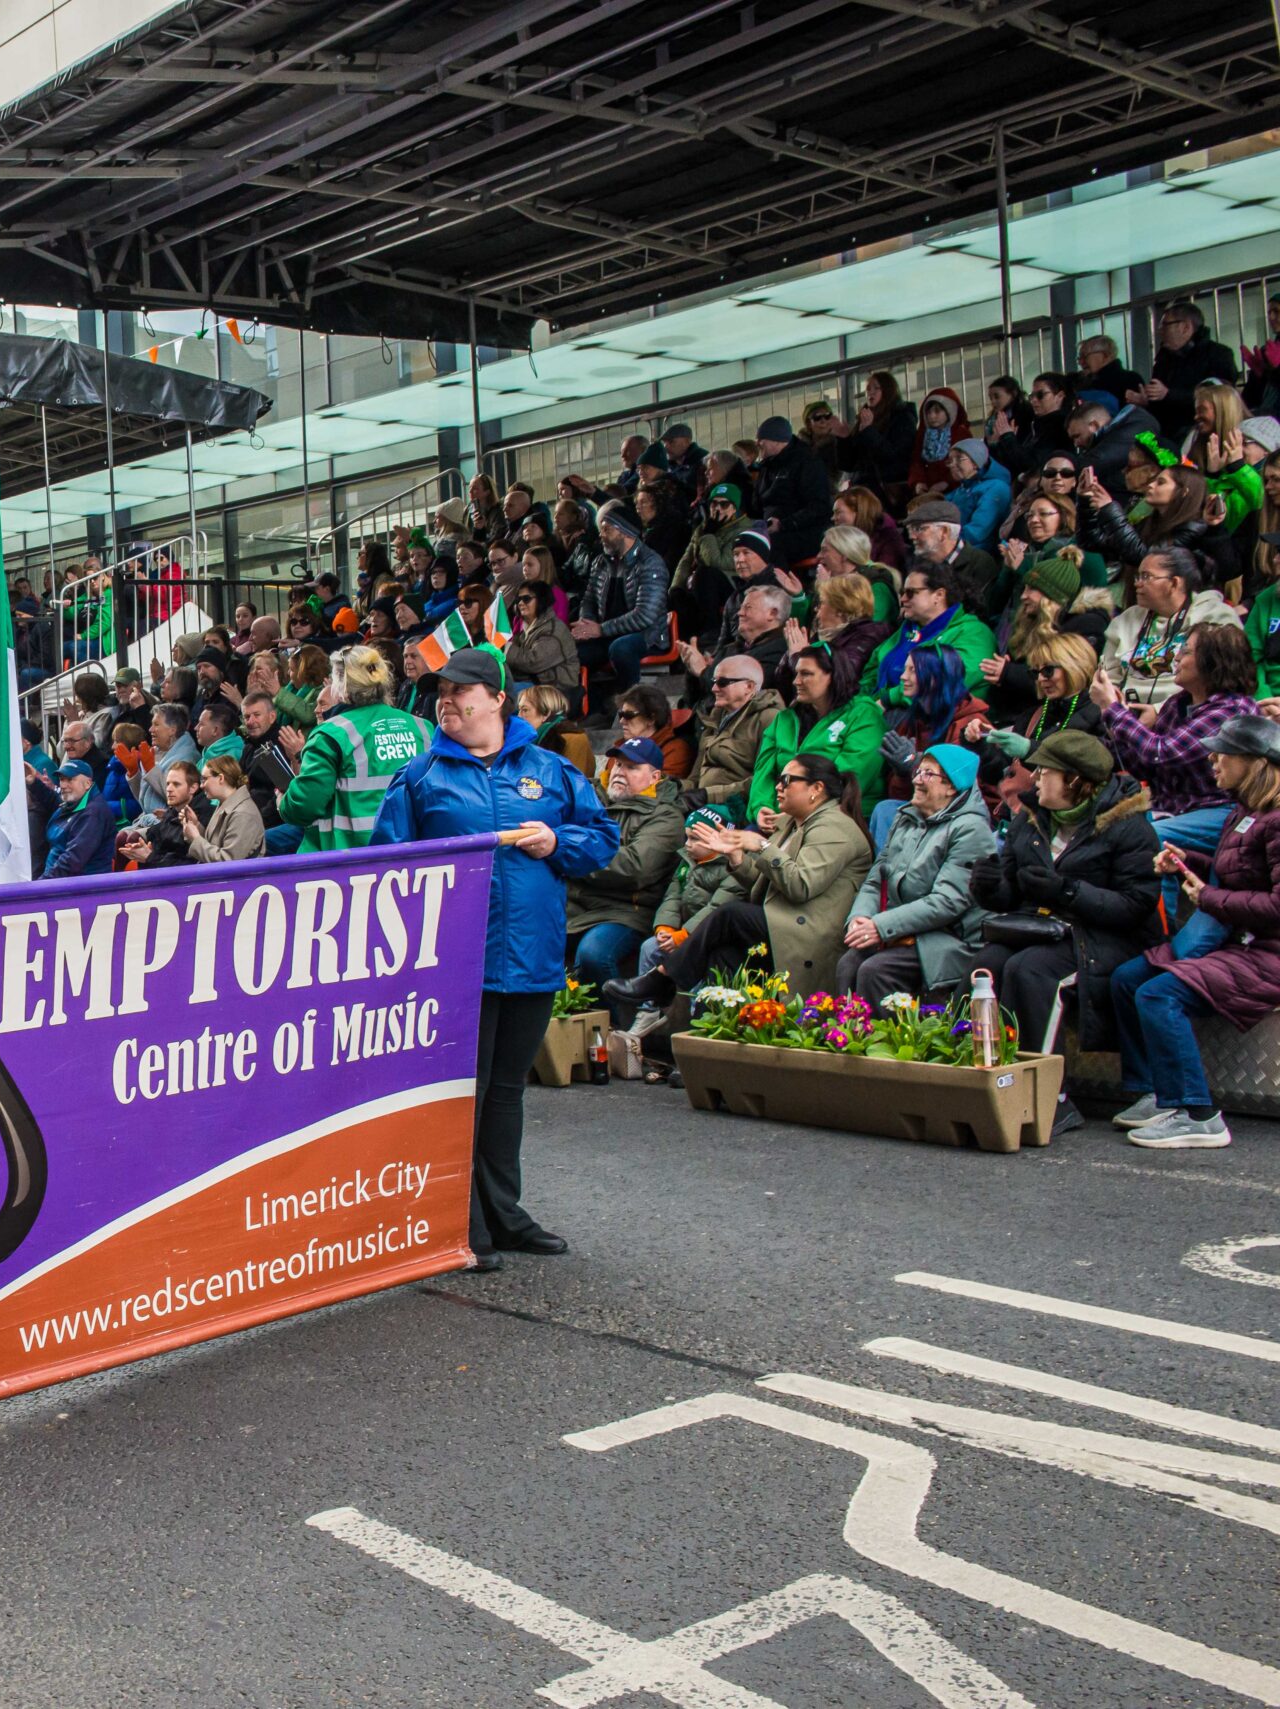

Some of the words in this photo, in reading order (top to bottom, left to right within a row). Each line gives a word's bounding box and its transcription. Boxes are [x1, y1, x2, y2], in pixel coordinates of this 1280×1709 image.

[374, 731, 416, 746] FESTIVALS
[376, 742, 417, 761] CREW
[112, 1025, 258, 1105] Centre
[273, 1009, 320, 1073] of
[330, 993, 440, 1067] Music
[244, 1170, 371, 1232] Limerick
[378, 1160, 431, 1200] City
[19, 1217, 431, 1354] www.redscentreofmusic.ie
